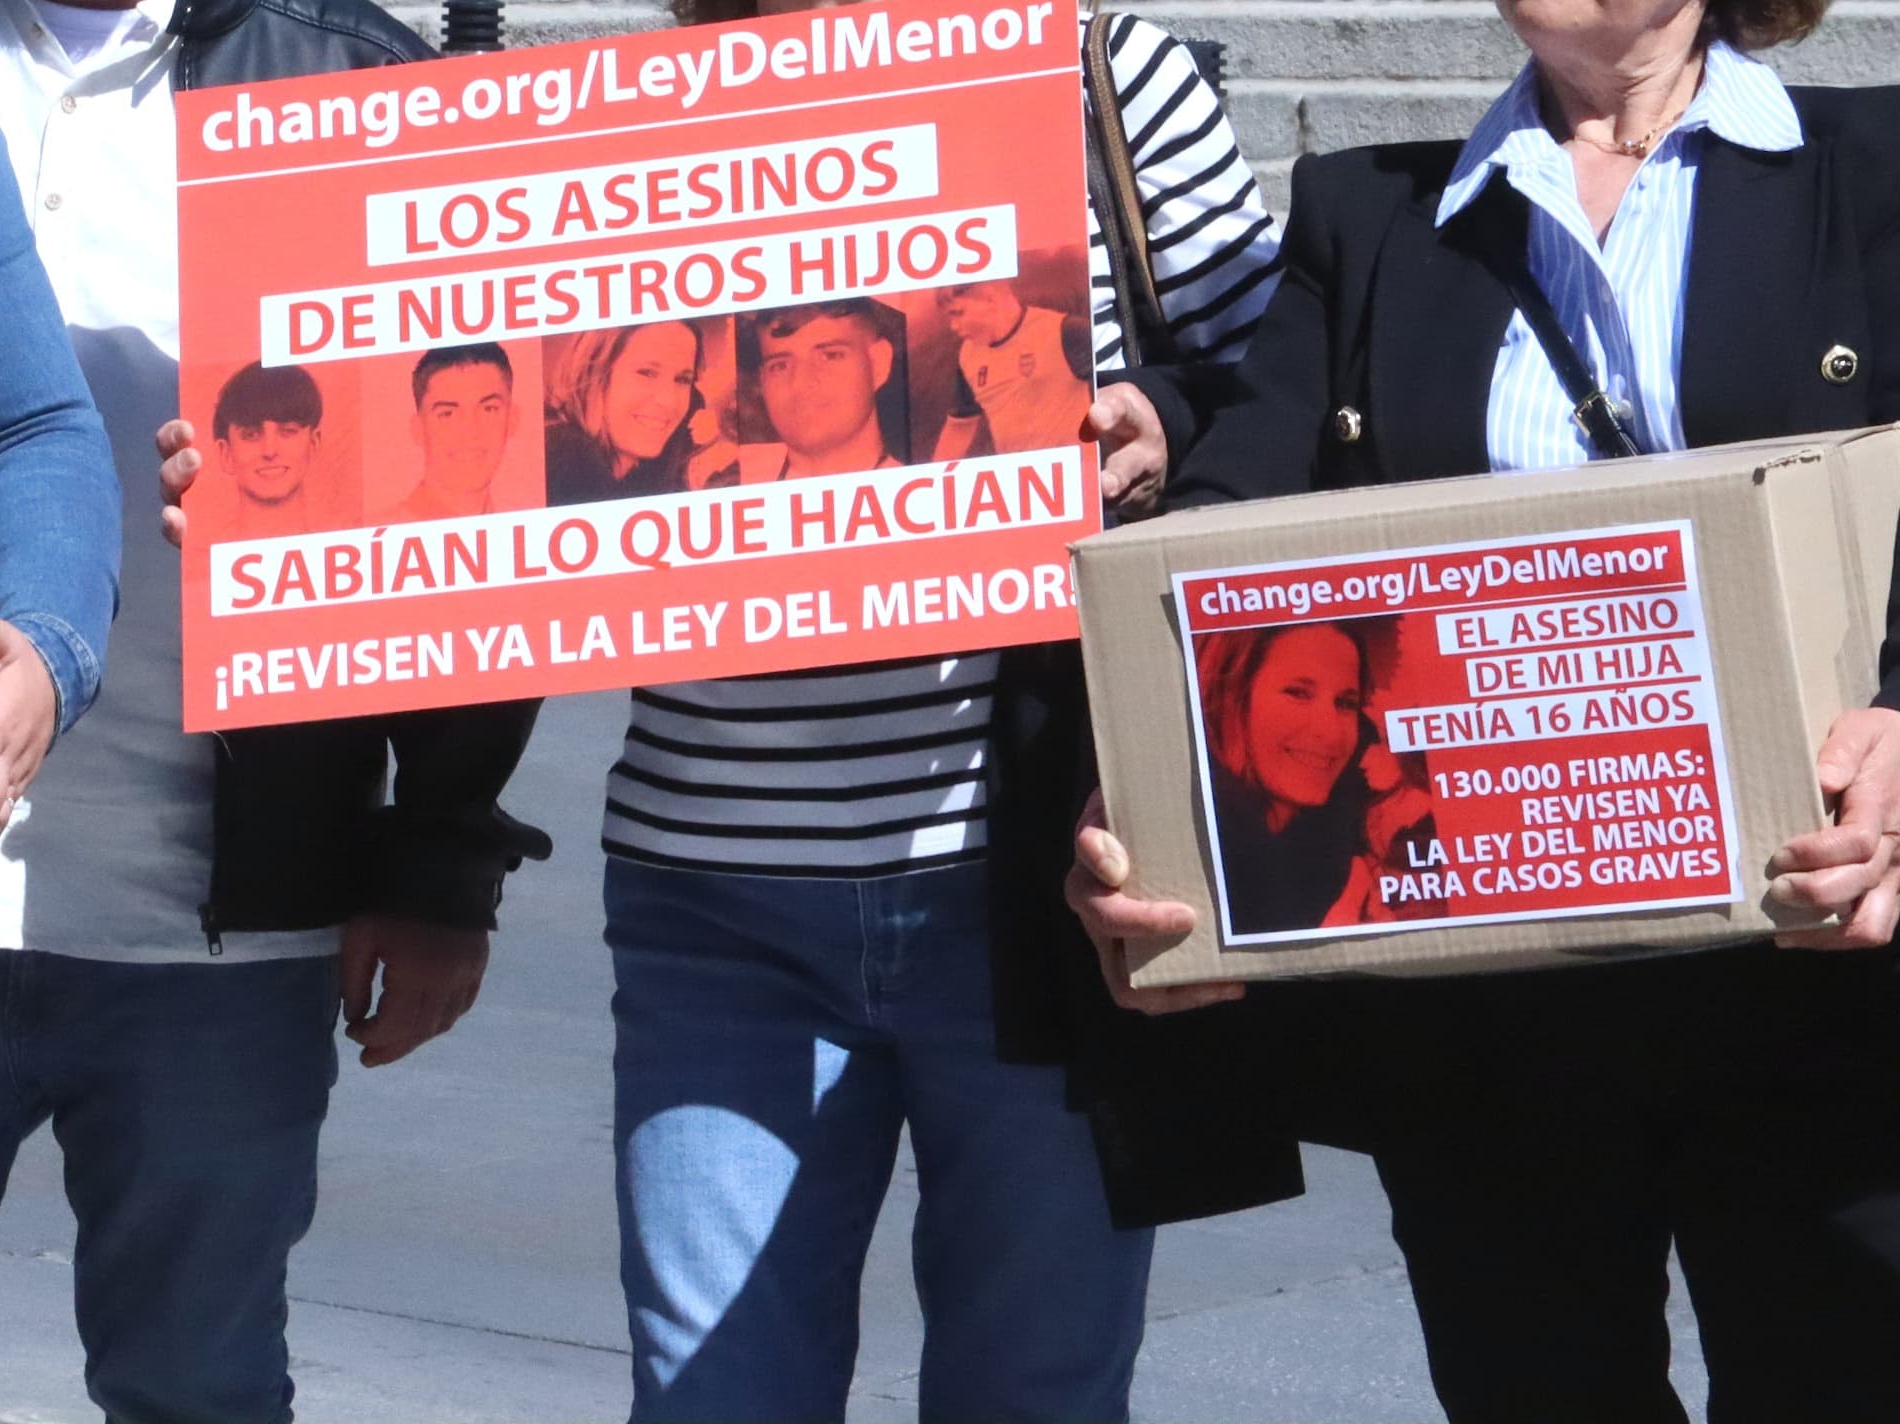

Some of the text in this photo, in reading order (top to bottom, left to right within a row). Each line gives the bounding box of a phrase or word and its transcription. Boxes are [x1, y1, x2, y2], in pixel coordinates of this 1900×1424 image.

[202, 0, 1052, 153] change.org/LeyDelMenor
[406, 141, 897, 253] LOS ASESINOS
[289, 218, 991, 355] DE NUESTROS HIJOS
[231, 462, 1064, 608] SABÍAN LO QUE HACÍAN
[1201, 542, 1667, 616] change.org/LeyDelMenor
[216, 632, 453, 710] ¡REVISEN
[466, 625, 534, 671] YA
[550, 616, 617, 663] LA
[633, 602, 728, 654] LEY
[744, 591, 847, 642] DEL
[1455, 599, 1678, 648] EL ASESINO
[1476, 644, 1683, 692] DE MI HIJA
[1398, 688, 1694, 748] TENÍA 16 AÑOS
[1435, 750, 1704, 798] 130.000 FIRMAS:
[1522, 784, 1710, 825] REVISEN YA
[1407, 815, 1716, 867] LA LEY DEL MENOR
[1380, 848, 1721, 902] PARA CASOS GRAVES
